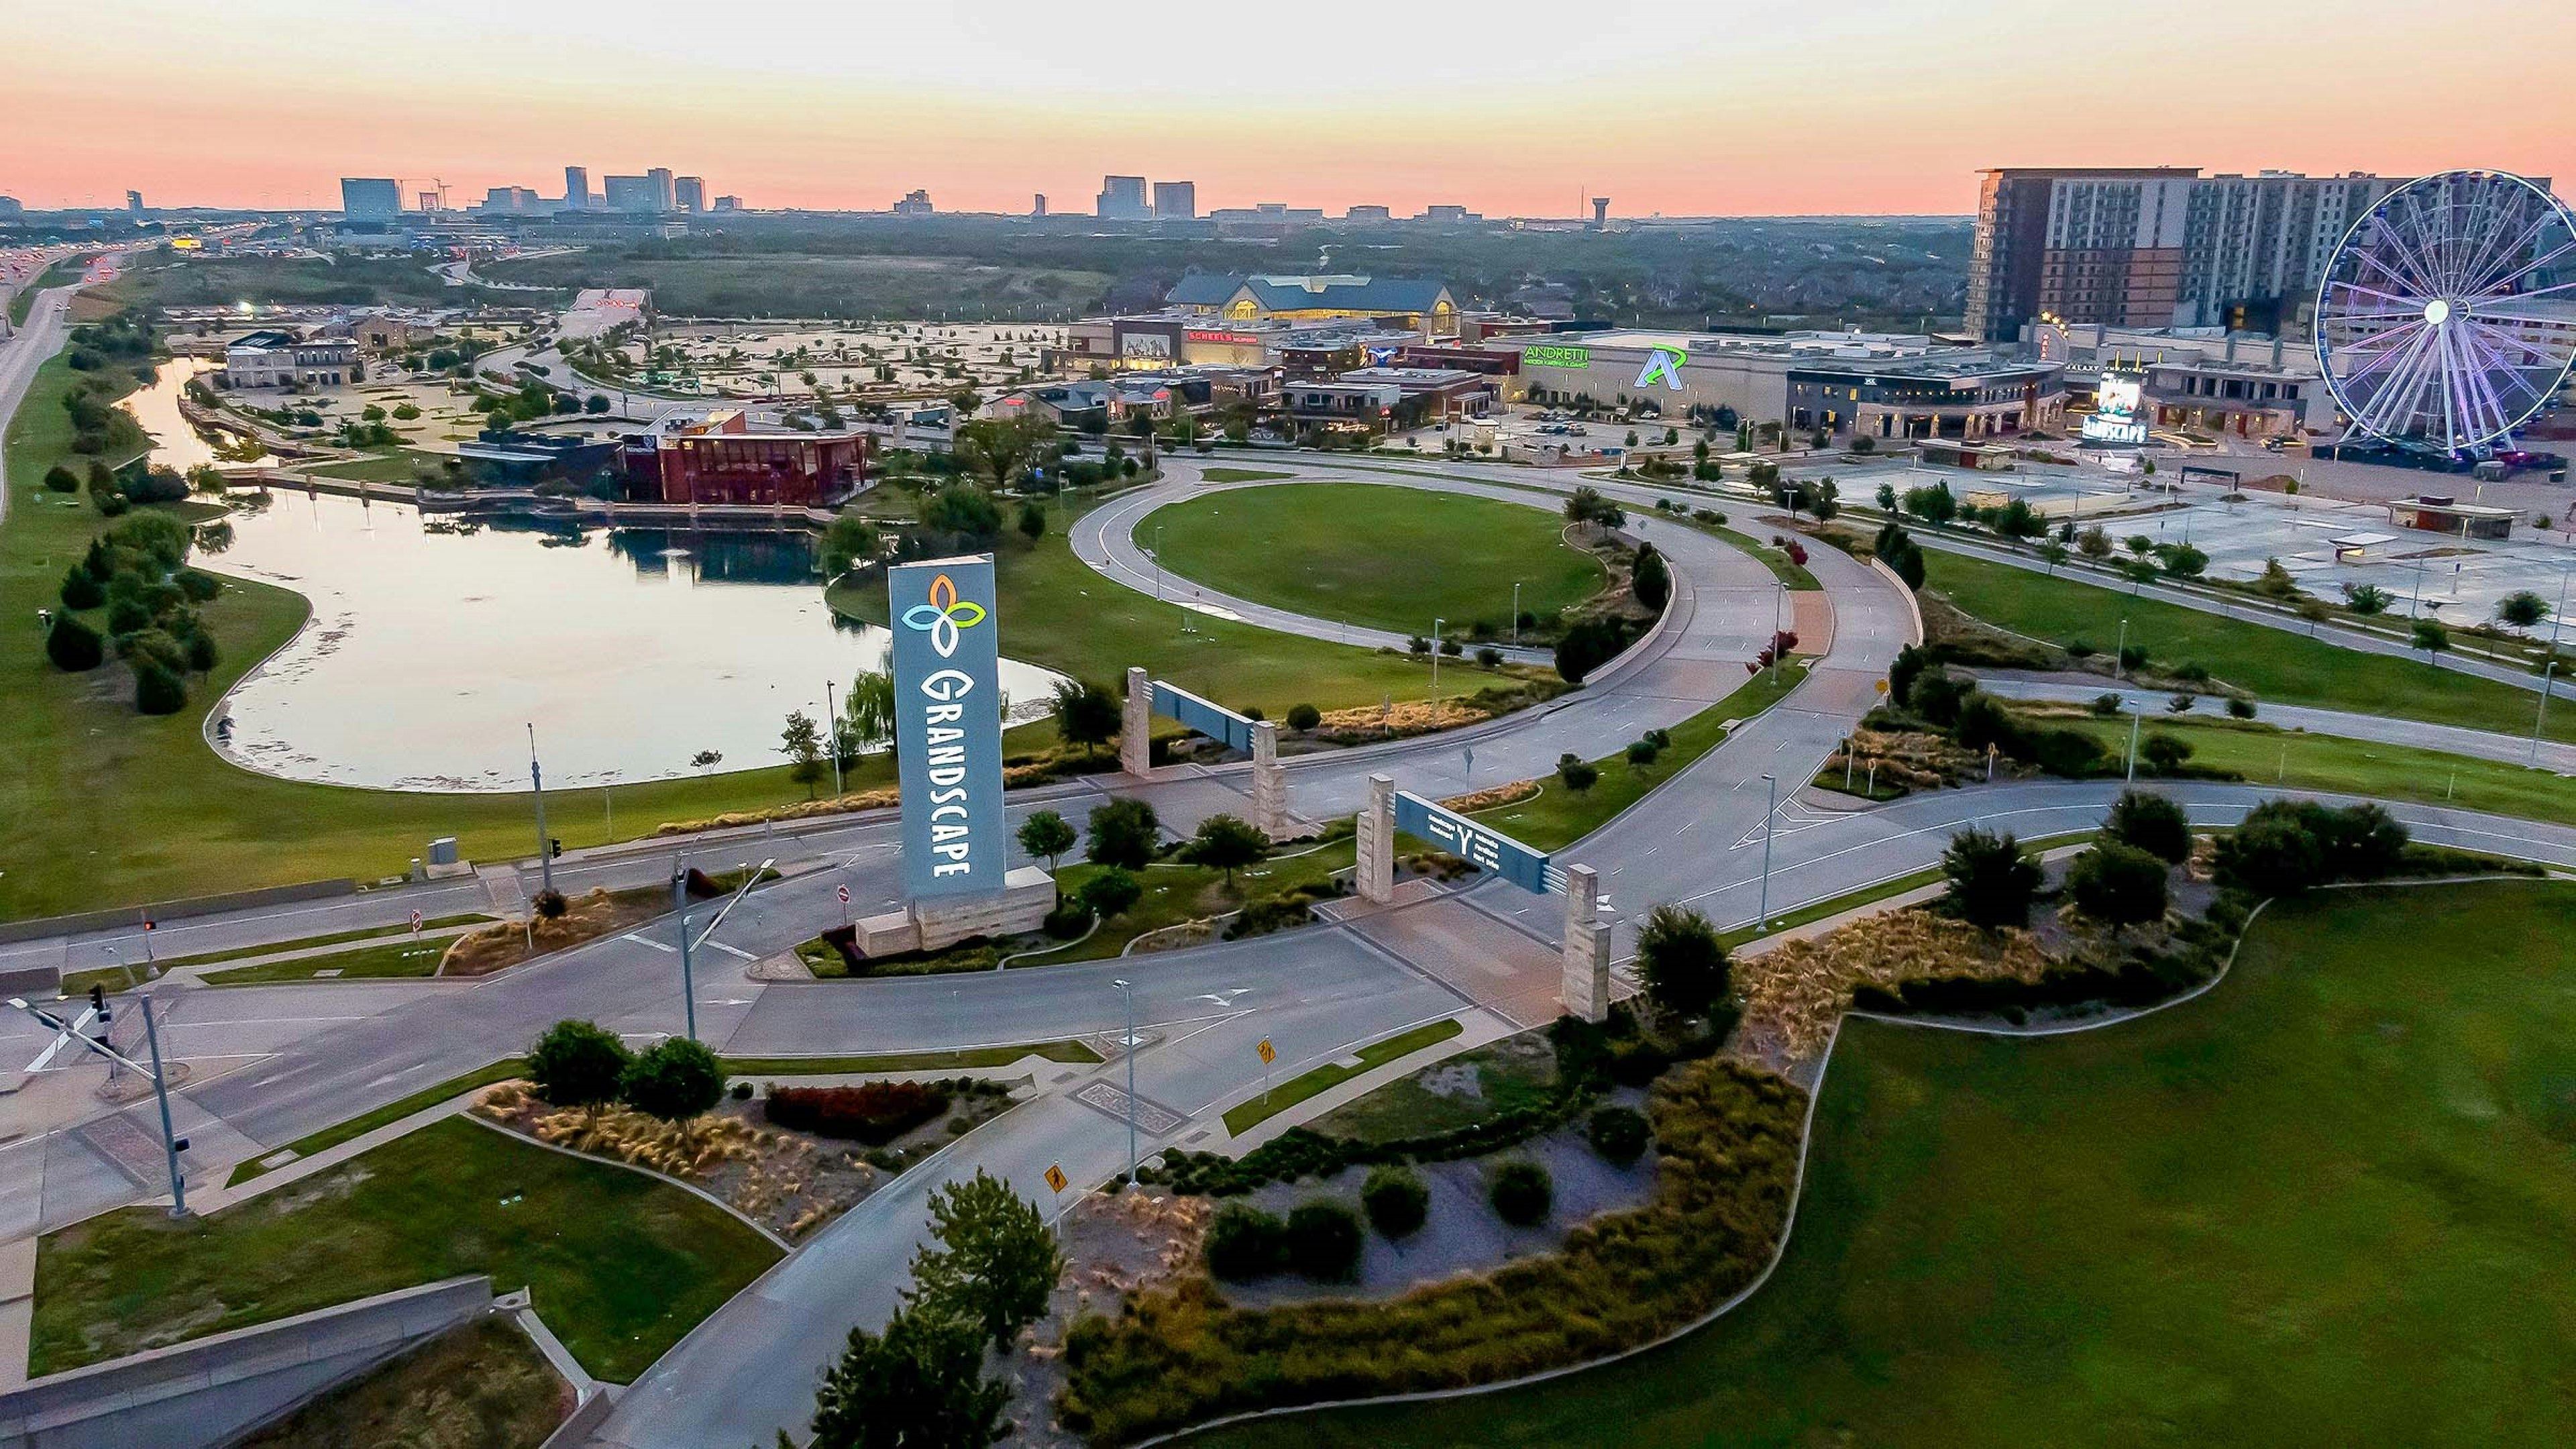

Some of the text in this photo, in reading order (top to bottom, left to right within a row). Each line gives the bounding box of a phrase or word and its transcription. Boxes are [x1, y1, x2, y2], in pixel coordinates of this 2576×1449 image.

[1188, 331, 1232, 341] SCHEELS
[1524, 345, 1589, 360] ANDRETTI
[920, 669, 975, 877] GRANDSCAPE
